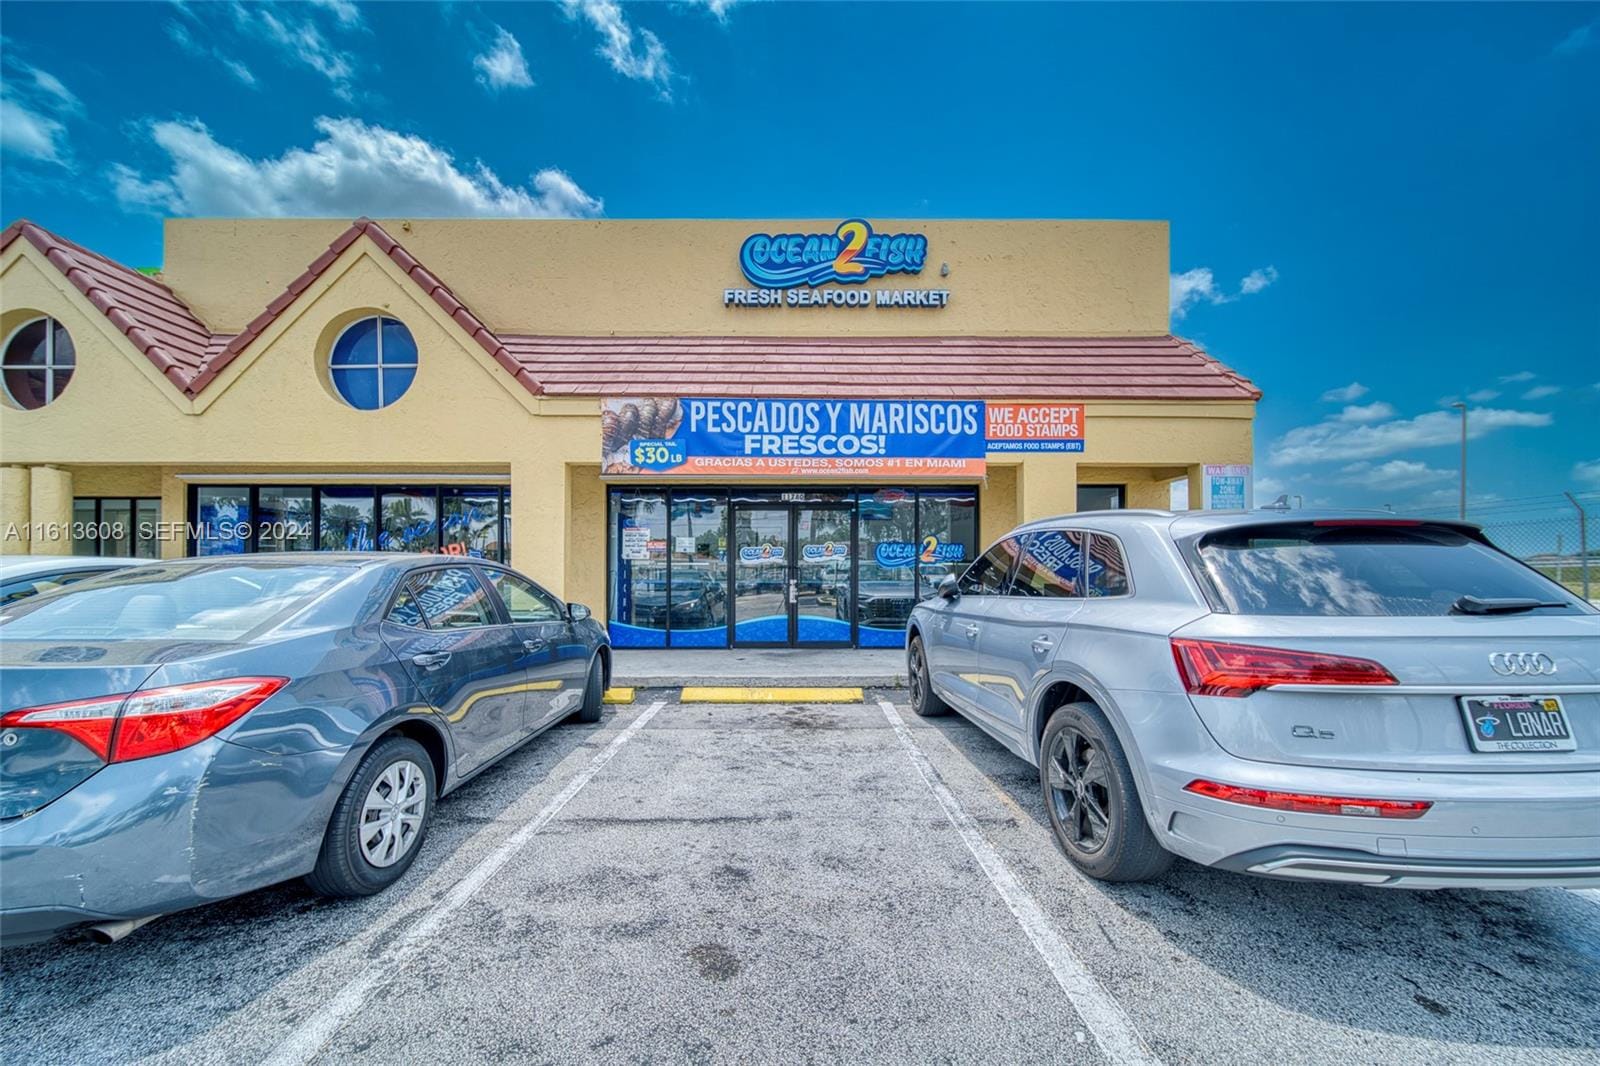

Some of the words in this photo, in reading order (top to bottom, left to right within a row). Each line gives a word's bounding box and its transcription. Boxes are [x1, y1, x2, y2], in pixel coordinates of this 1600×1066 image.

[753, 236, 840, 265] OCEAN
[833, 221, 867, 273] 2
[867, 236, 925, 265] FISH
[724, 289, 782, 305] FRESH
[786, 290, 872, 305] SEAFOOD
[876, 290, 950, 306] MARKET
[690, 401, 820, 433] PESCADOS
[825, 402, 842, 433] Y
[850, 402, 978, 435] MARISCOS
[989, 407, 1014, 424] WE
[1017, 407, 1080, 424] ACCEPT
[989, 423, 1023, 437] FOOD
[1026, 423, 1079, 437] STAMPS
[744, 434, 887, 455] FRESCOS!
[987, 442, 1023, 450] ACEPTAMOS
[1024, 442, 1039, 450] FOOD
[1041, 442, 1065, 450] STAMPS
[634, 447, 669, 464] $30
[671, 454, 682, 463] LB
[695, 457, 752, 468] GRACIAS
[756, 458, 766, 468] A
[768, 457, 832, 468] USTEDES,
[835, 458, 884, 468] SOMOS
[887, 458, 901, 468] #1
[905, 458, 922, 468] EN
[926, 459, 966, 468] MIAMI
[1207, 466, 1248, 475] WARING
[921, 536, 938, 562] 2
[936, 543, 964, 558] FISH
